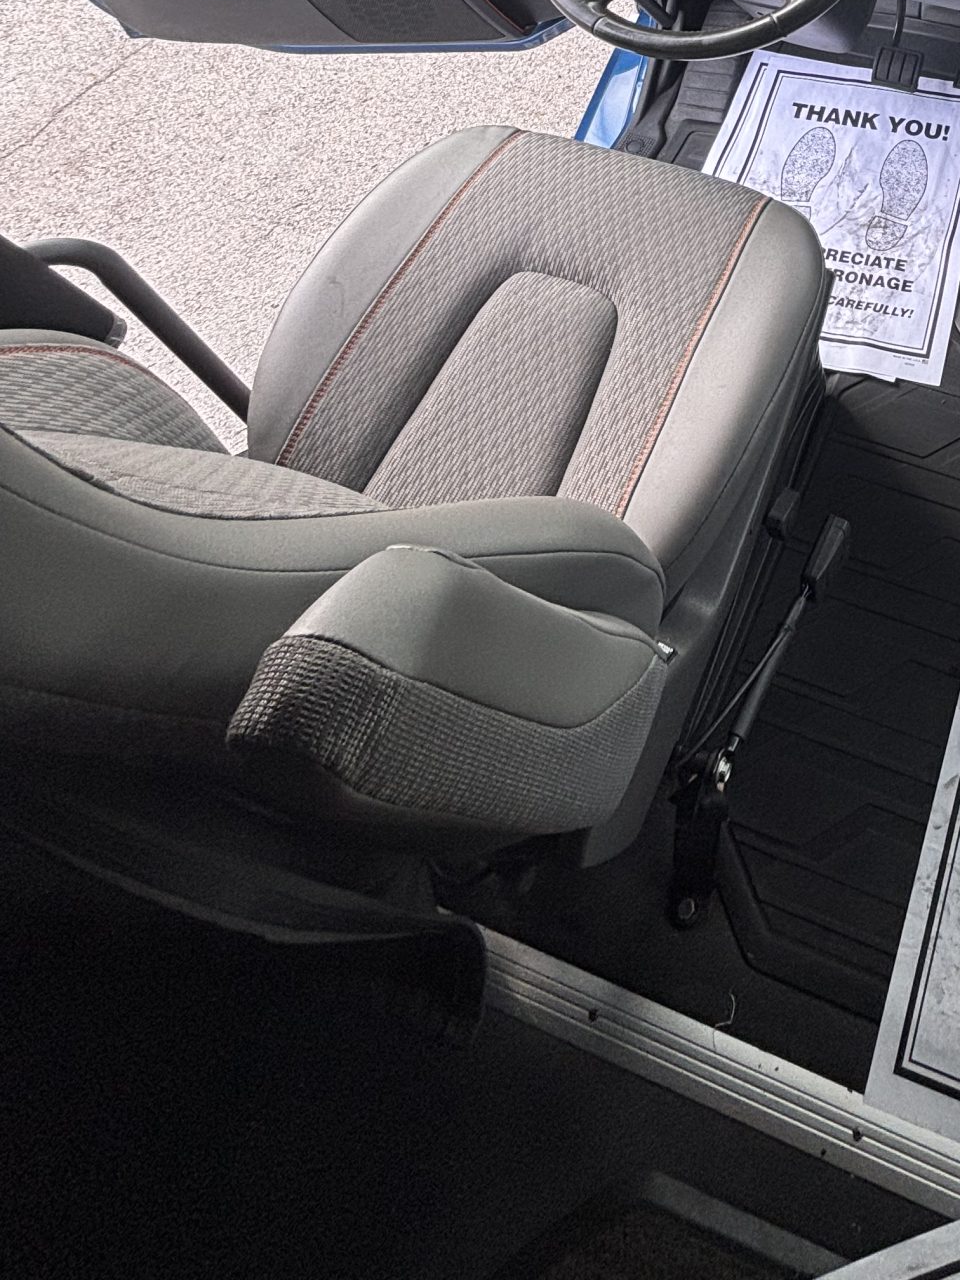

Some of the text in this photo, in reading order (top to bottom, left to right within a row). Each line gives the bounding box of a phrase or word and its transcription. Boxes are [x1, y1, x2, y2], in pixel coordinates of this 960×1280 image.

[792, 102, 951, 141] THANK YOU!
[823, 247, 908, 272] RECIATE
[833, 268, 914, 293] RONAGE
[828, 295, 915, 319] CAREFULLY!
